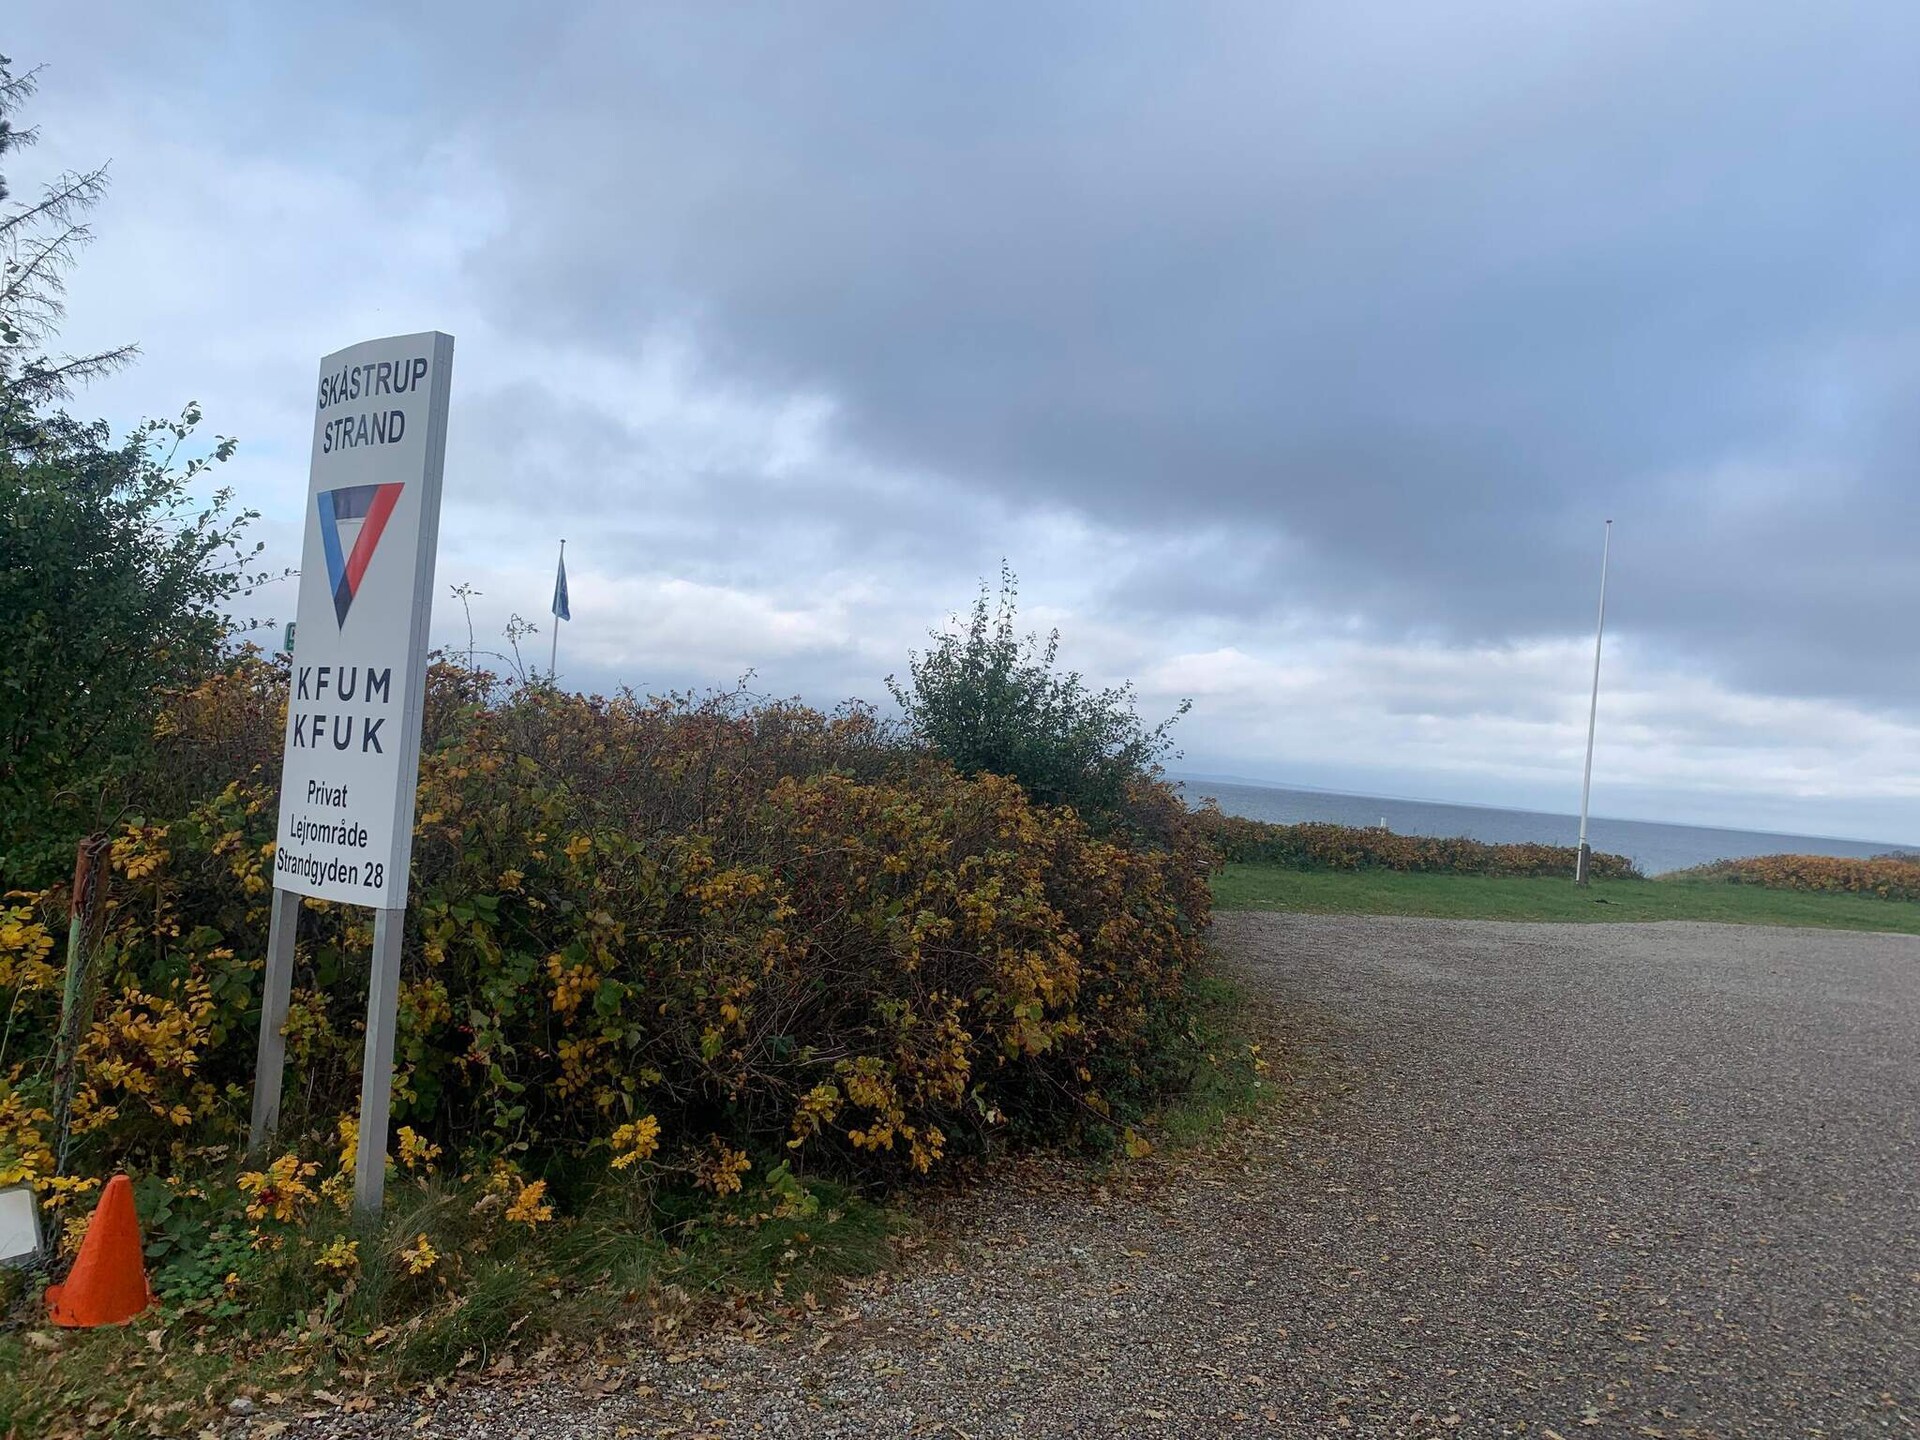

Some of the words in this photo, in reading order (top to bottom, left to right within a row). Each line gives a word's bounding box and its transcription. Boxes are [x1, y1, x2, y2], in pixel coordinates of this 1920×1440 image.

[319, 357, 428, 410] SKÅSTRUP
[323, 410, 405, 454] STRAND
[297, 666, 391, 703] KFUM
[293, 714, 386, 754] KFUK
[307, 779, 347, 808] Privat
[290, 813, 368, 848] Lejrområde
[277, 847, 358, 886] Strandgyden
[363, 861, 384, 889] 28
